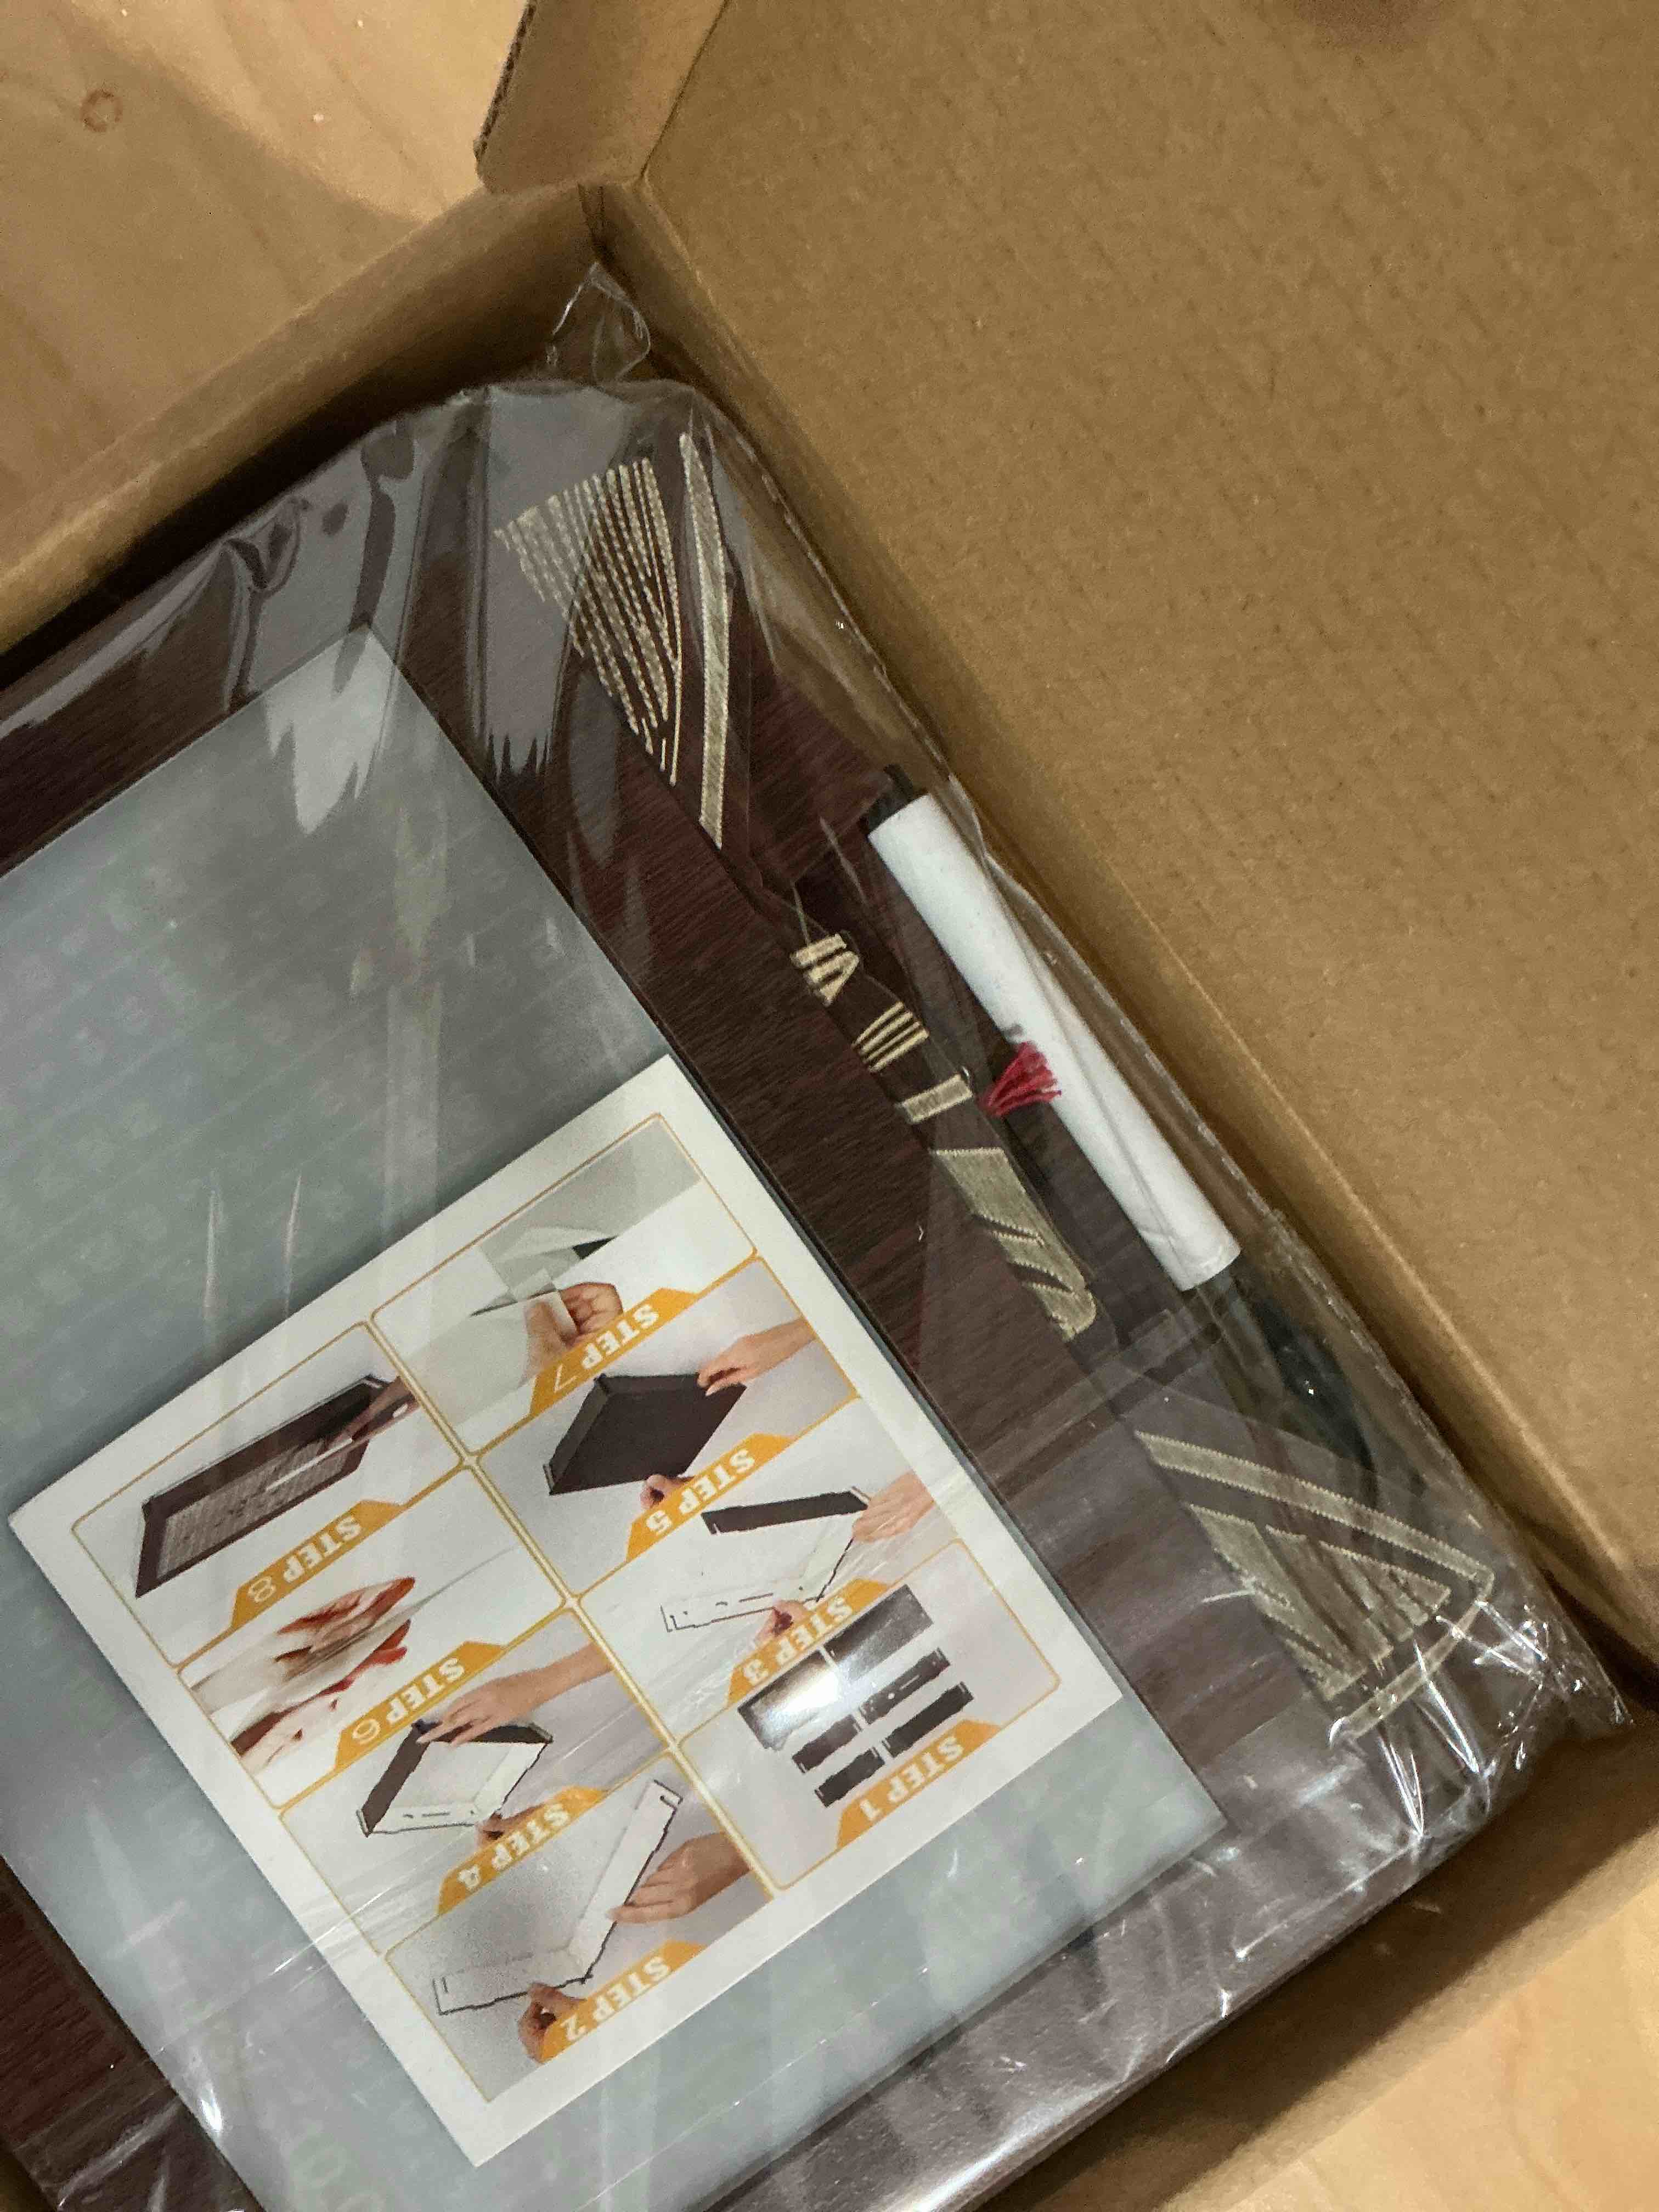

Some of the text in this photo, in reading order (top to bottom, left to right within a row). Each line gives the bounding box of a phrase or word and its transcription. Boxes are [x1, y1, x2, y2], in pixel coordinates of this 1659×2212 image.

[552, 1303, 660, 1393] STEP 7
[646, 1448, 757, 1536] STEP 5
[247, 1515, 363, 1604] STEP 8
[742, 1596, 854, 1685] STEP 3
[351, 1657, 466, 1744] STEP 6
[859, 1735, 965, 1821] STEP 1
[456, 1802, 571, 1893] STEP 4
[559, 1955, 672, 2042] STEP 2
